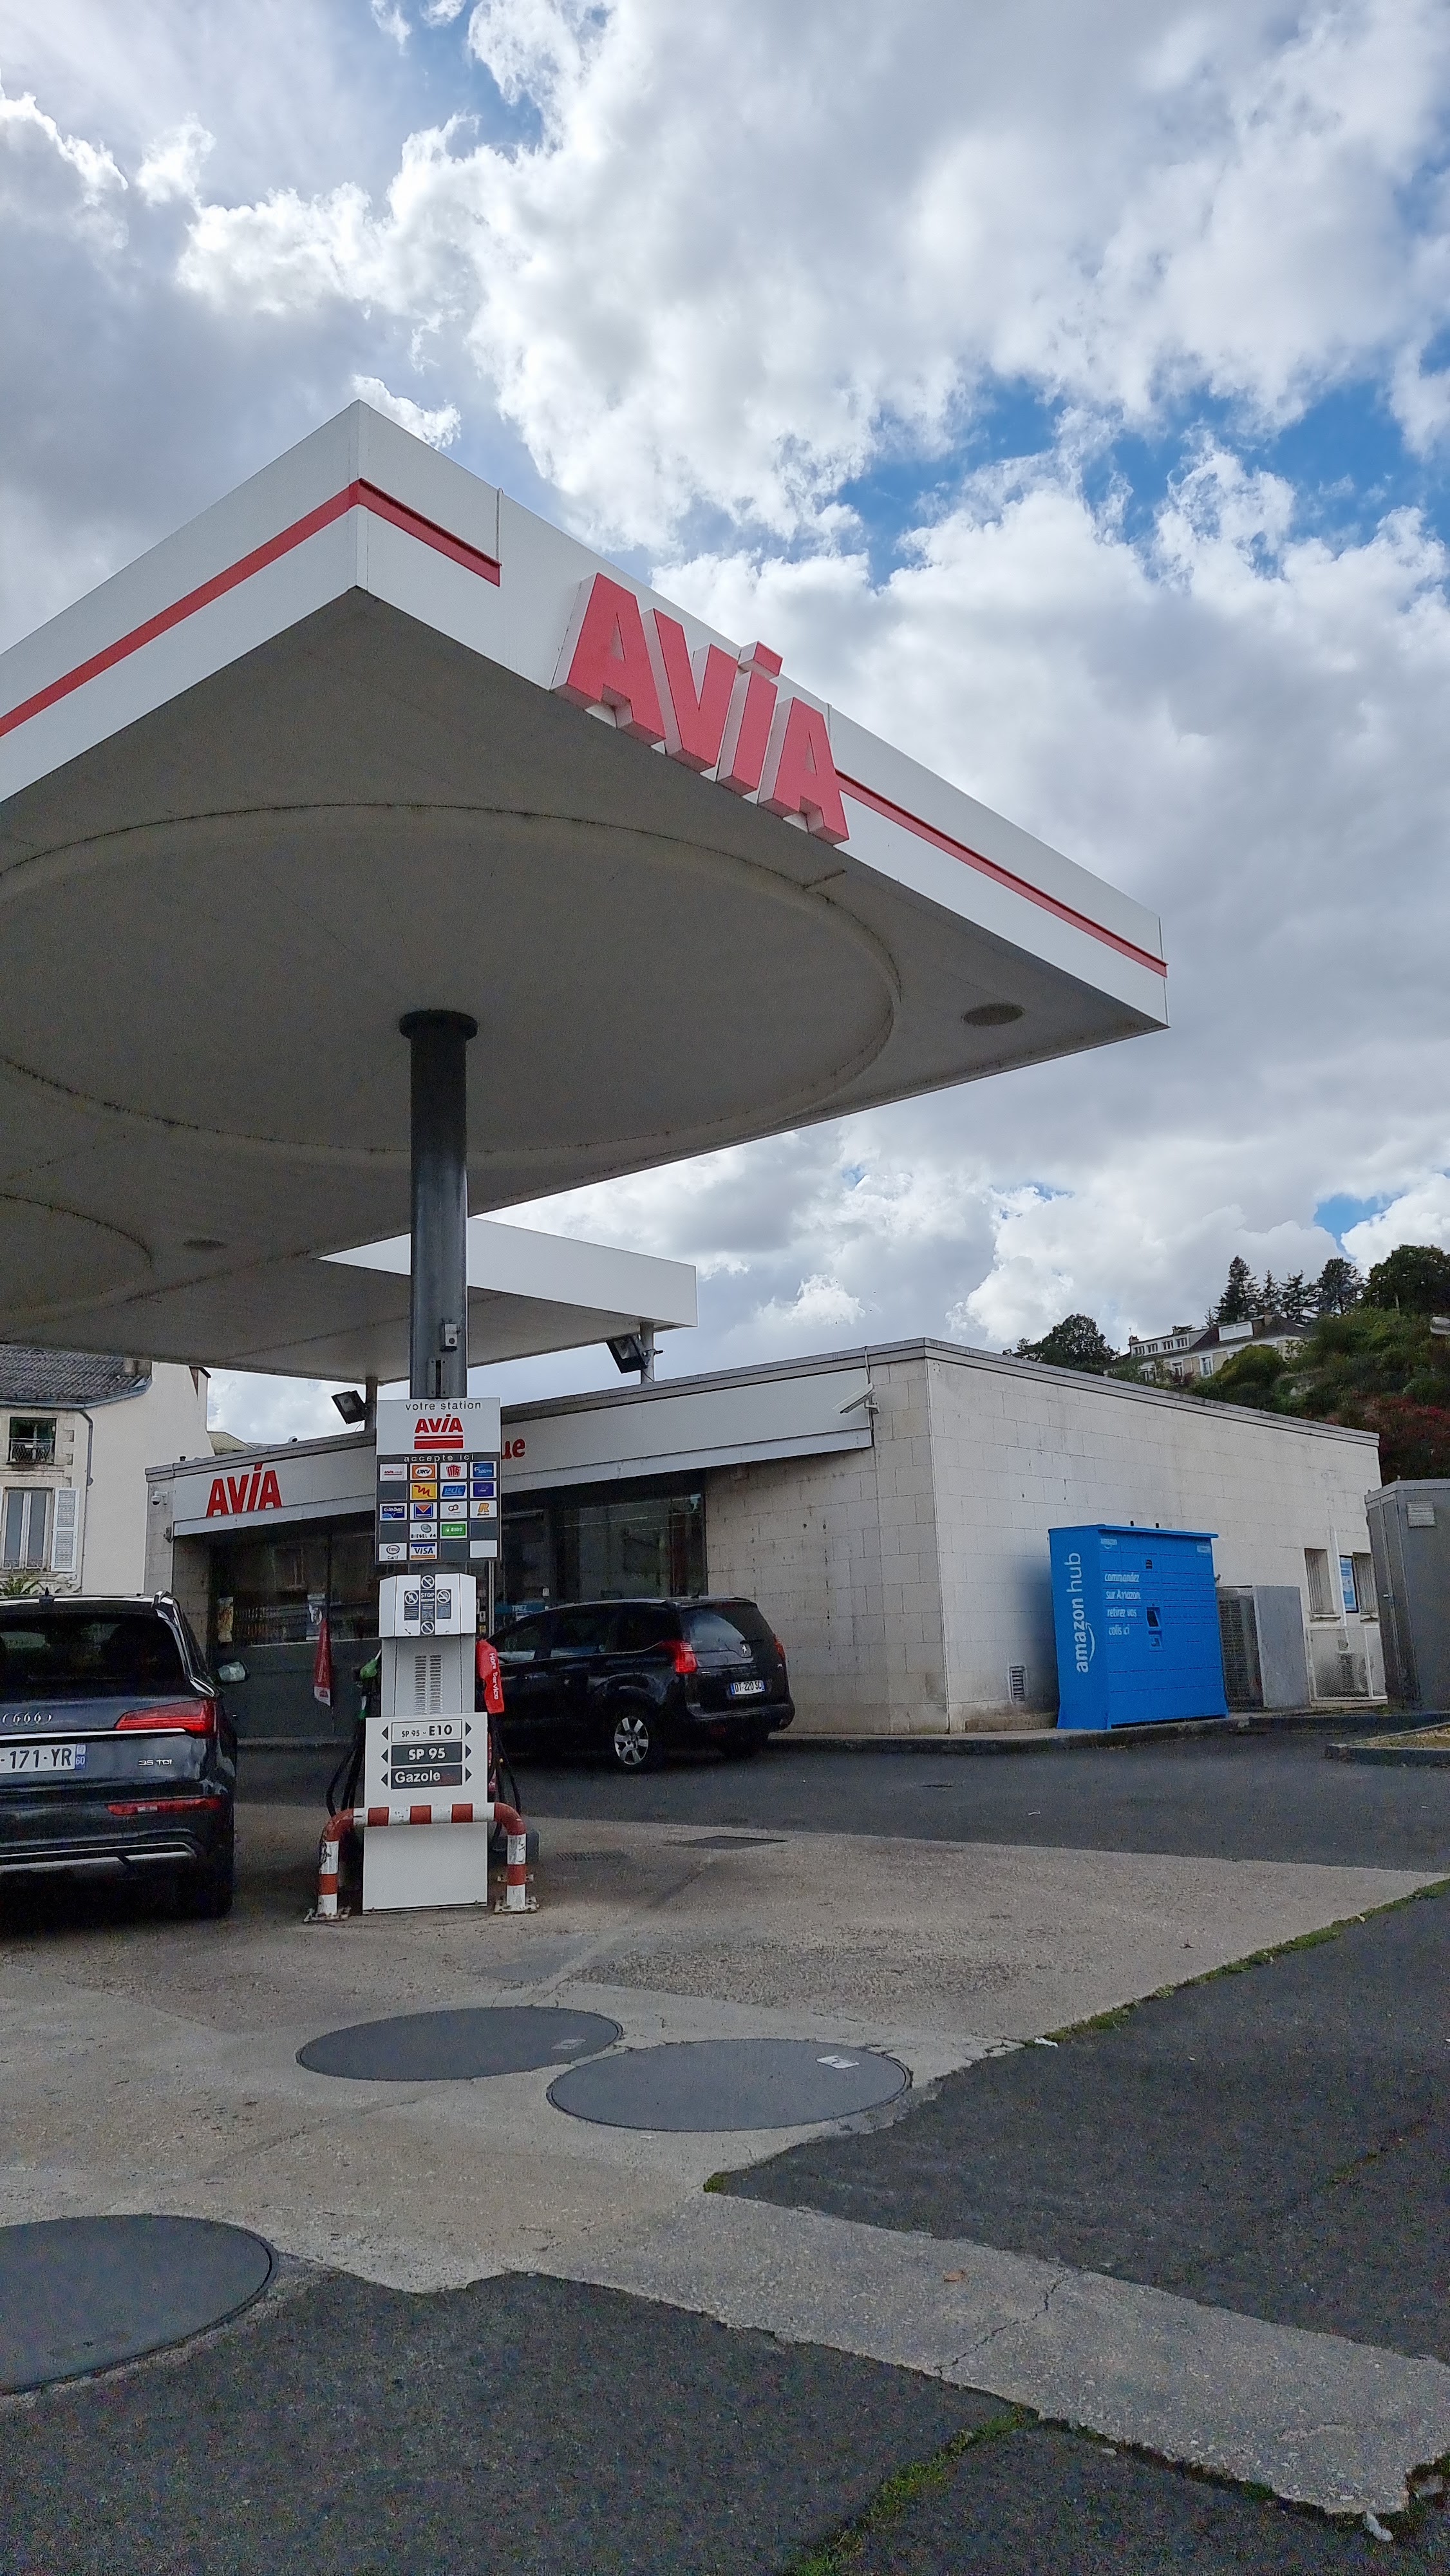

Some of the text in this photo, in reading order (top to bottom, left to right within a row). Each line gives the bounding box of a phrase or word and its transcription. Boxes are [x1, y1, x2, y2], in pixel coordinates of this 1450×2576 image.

[405, 1400, 482, 1411] votre station
[1064, 1552, 1089, 1673] amazon hub
[401, 1730, 410, 1738] SP
[429, 1724, 453, 1736] E10
[75, 1756, 85, 1765] 60
[408, 1747, 446, 1761] SP 95
[395, 1769, 441, 1783] Gazole
